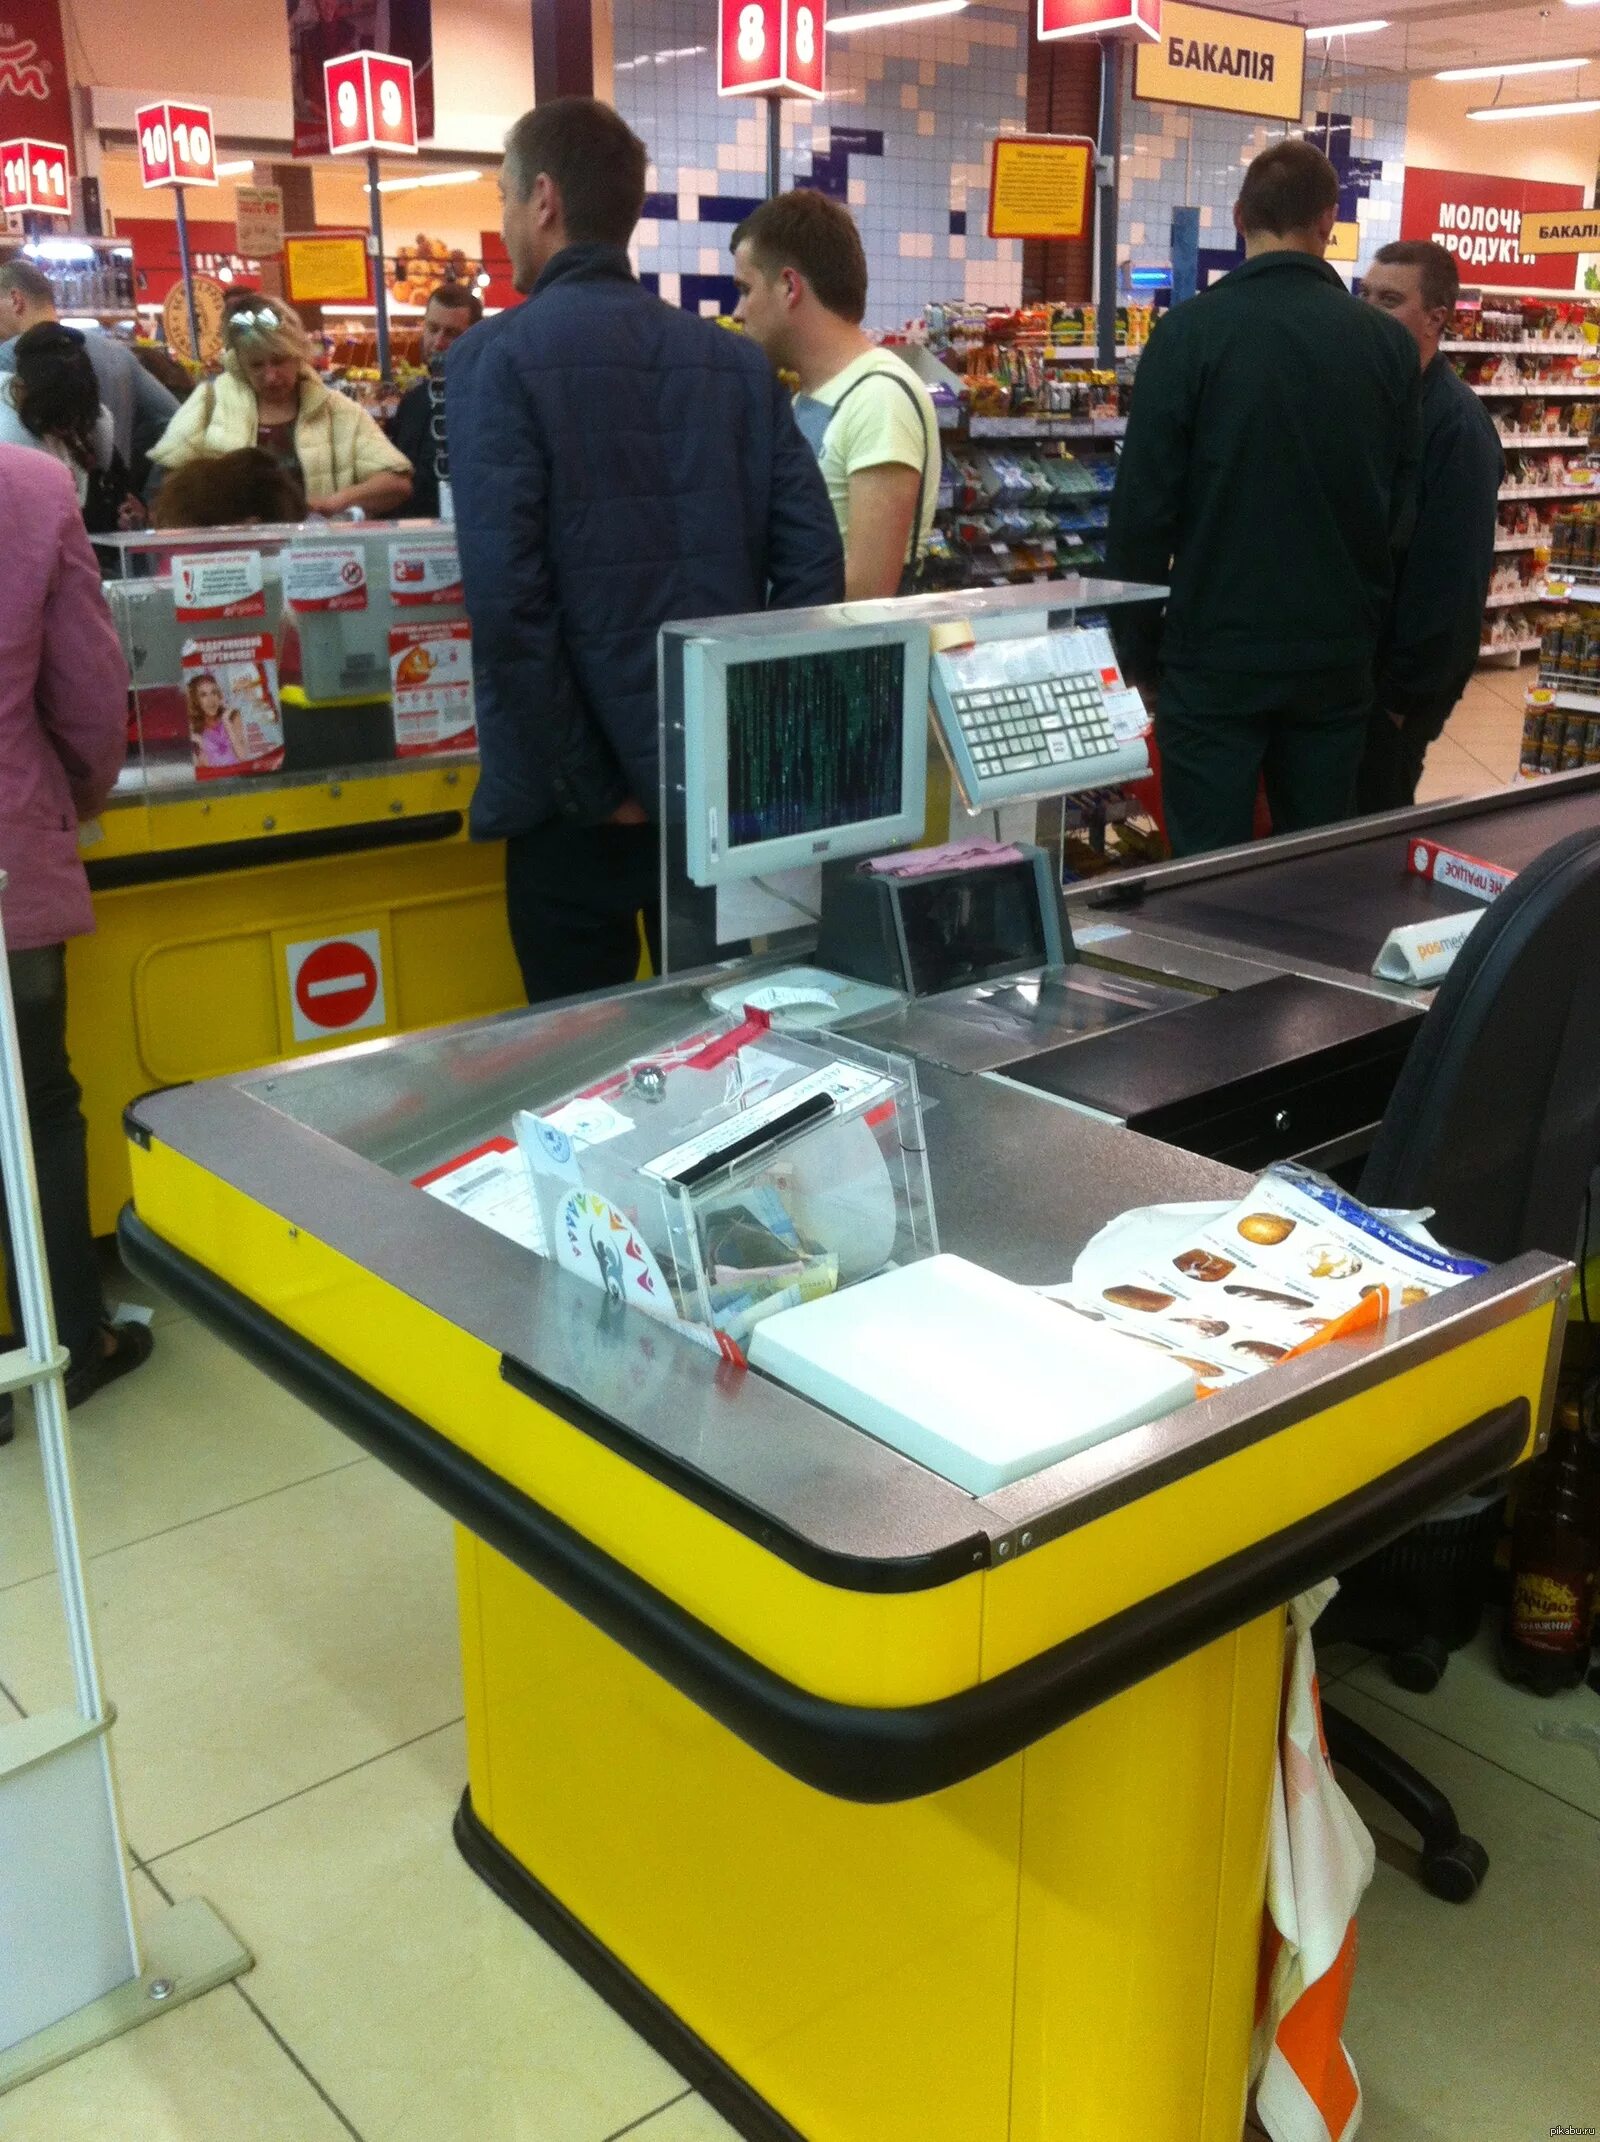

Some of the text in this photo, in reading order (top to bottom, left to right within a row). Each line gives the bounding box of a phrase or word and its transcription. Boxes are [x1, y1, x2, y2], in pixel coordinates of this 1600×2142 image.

[737, 3, 766, 62] 8
[795, 6, 815, 64] 8
[1168, 36, 1275, 82] БАКАЛІЯ
[337, 80, 358, 128] 9
[380, 79, 403, 127] 9
[142, 124, 168, 166] 10
[172, 123, 211, 166] 10
[4, 158, 26, 195] 11
[32, 159, 65, 196] 11
[1538, 225, 1600, 240] БАКАЛІ
